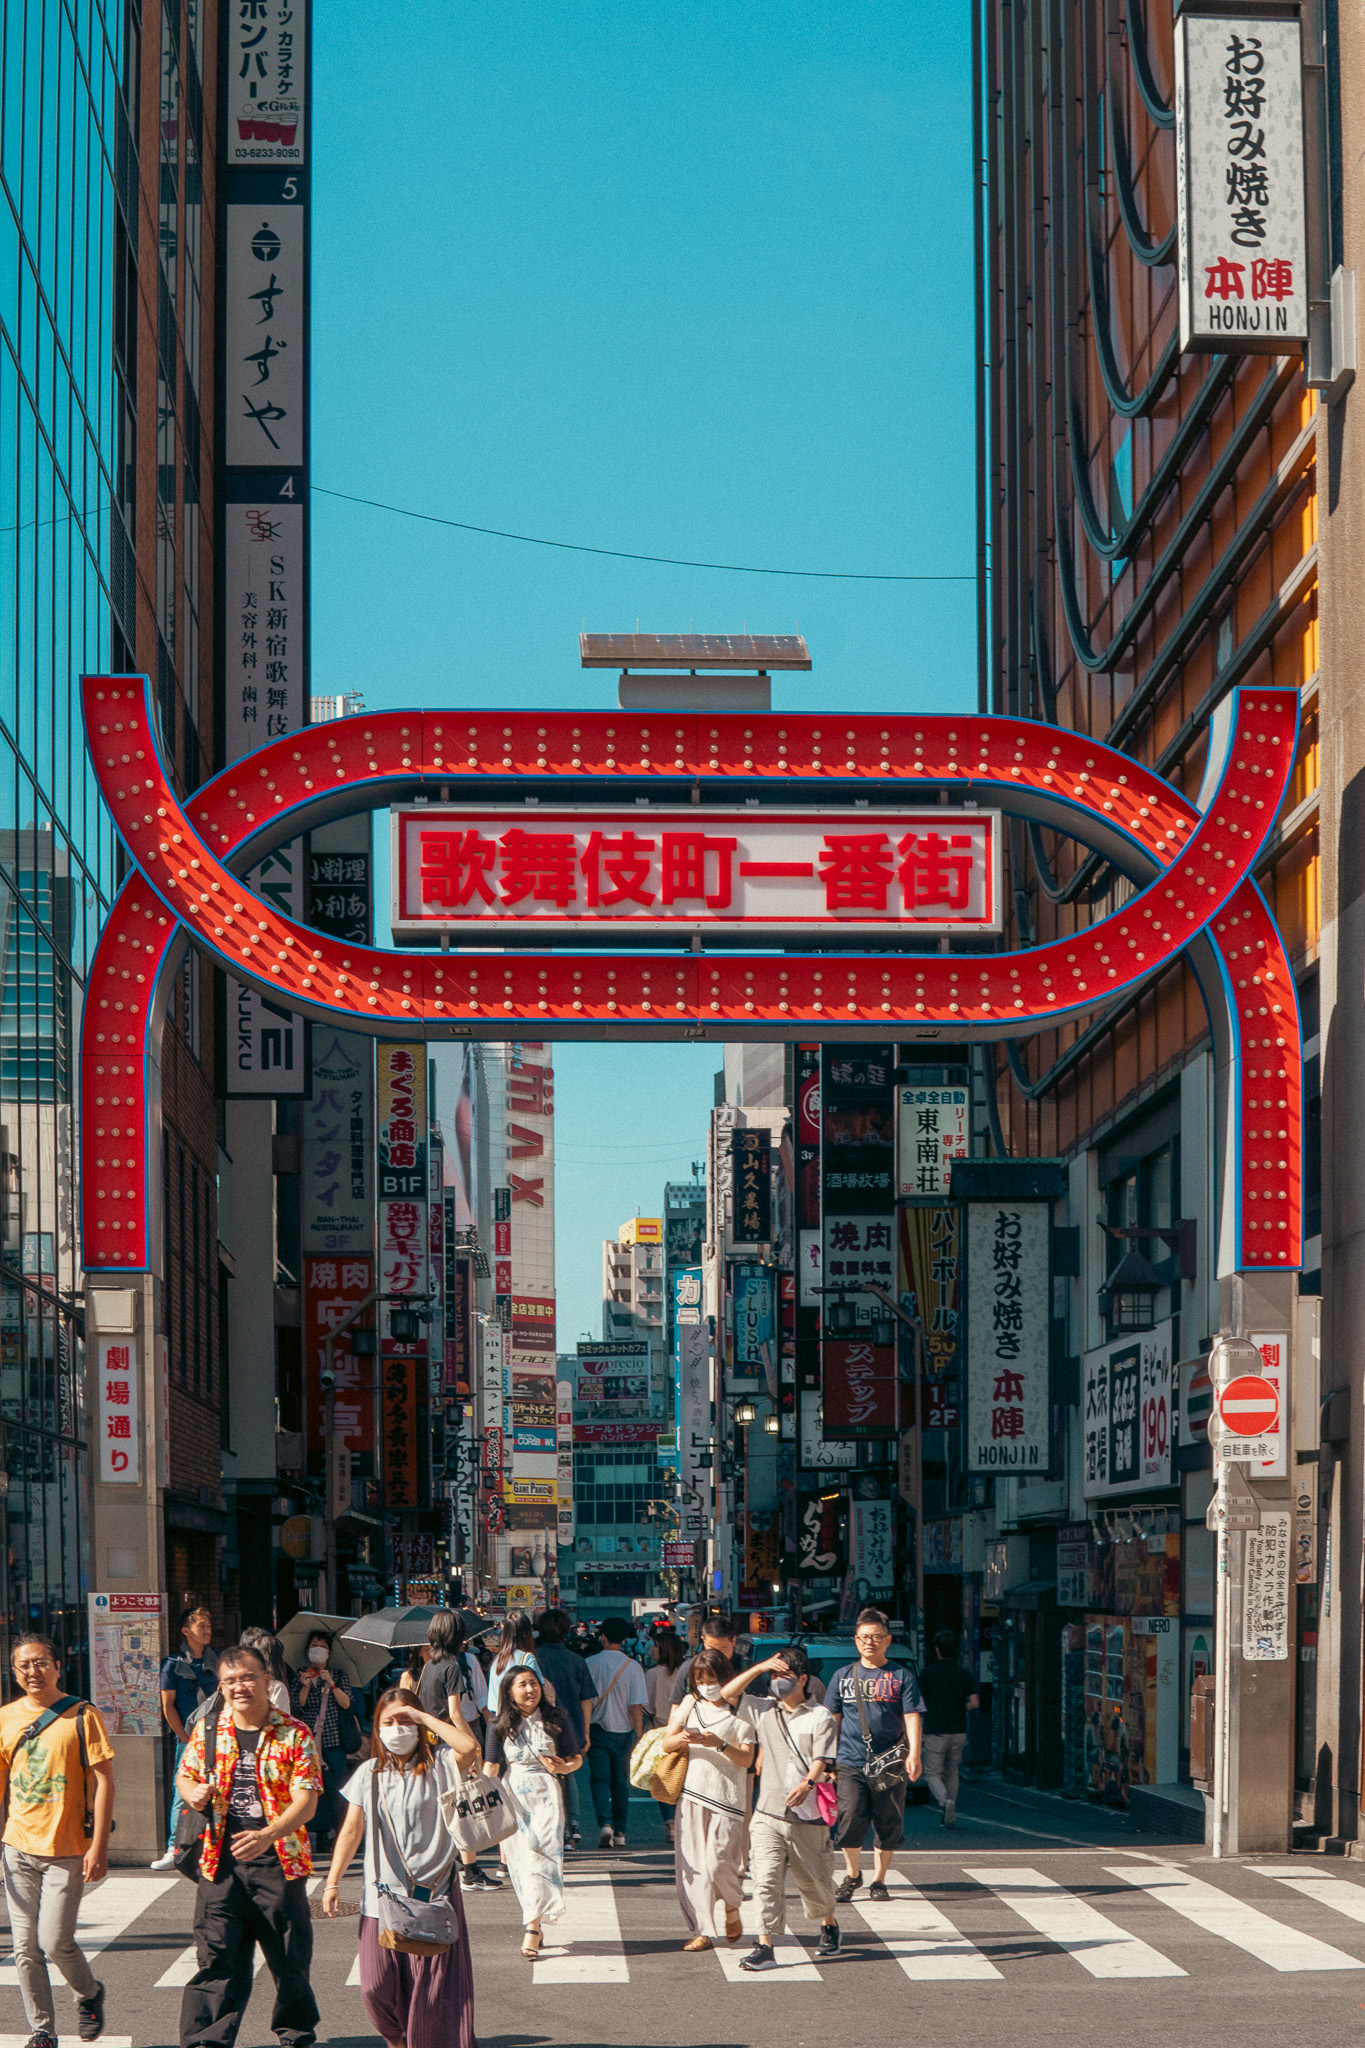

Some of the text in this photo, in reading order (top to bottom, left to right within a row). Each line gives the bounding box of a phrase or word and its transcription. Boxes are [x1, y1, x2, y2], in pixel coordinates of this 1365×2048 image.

[278, 31, 293, 95] カラオケ
[235, 149, 300, 158] 03-6233-9090
[1224, 34, 1269, 248] お好み焼き
[282, 177, 298, 200] 5
[1205, 256, 1294, 302] 本陣
[1209, 305, 1287, 332] HONJIN
[242, 273, 287, 450] すずや
[279, 477, 295, 499] 4
[420, 828, 974, 911] 歌舞伎町一番街
[801, 1069, 813, 1078] 4F
[389, 1050, 416, 1169] まぐろ商店
[902, 1091, 966, 1105] 全卓全自動
[311, 1089, 345, 1208] バンタイ
[801, 1151, 814, 1160] 3F
[915, 1107, 940, 1194] 東南荘
[942, 1135, 953, 1185] 専門店
[383, 1176, 422, 1193] B1F
[742, 1153, 761, 1230] 山久農場
[901, 1182, 914, 1194] 3F
[311, 1223, 365, 1231] RESTAURANT
[830, 1221, 892, 1251] 焼肉
[325, 1235, 350, 1249] 3F
[309, 1262, 369, 1289] 焼肉
[740, 1266, 765, 1277] 麻雀
[930, 1210, 957, 1333] ハイボール
[992, 1210, 1025, 1360] お好み焼き
[392, 1342, 416, 1355] 4F
[744, 1365, 761, 1376] 4F
[844, 1343, 878, 1424] ステップ
[106, 1346, 131, 1472] 劇場通り
[929, 1409, 957, 1426] 2F
[991, 1368, 1026, 1440] 本陣
[1143, 1395, 1168, 1459] 190
[836, 1456, 856, 1465] B1F
[977, 1445, 1039, 1466] HONJIN
[1223, 1444, 1275, 1457] 自転車を除く
[514, 1482, 530, 1493] GAME
[1255, 1525, 1265, 1580] For Your Safety
[1246, 1537, 1257, 1643] Security Camera in Operation
[1261, 1524, 1277, 1634] 防犯カメラ作動中
[1148, 1618, 1170, 1634] NERO
